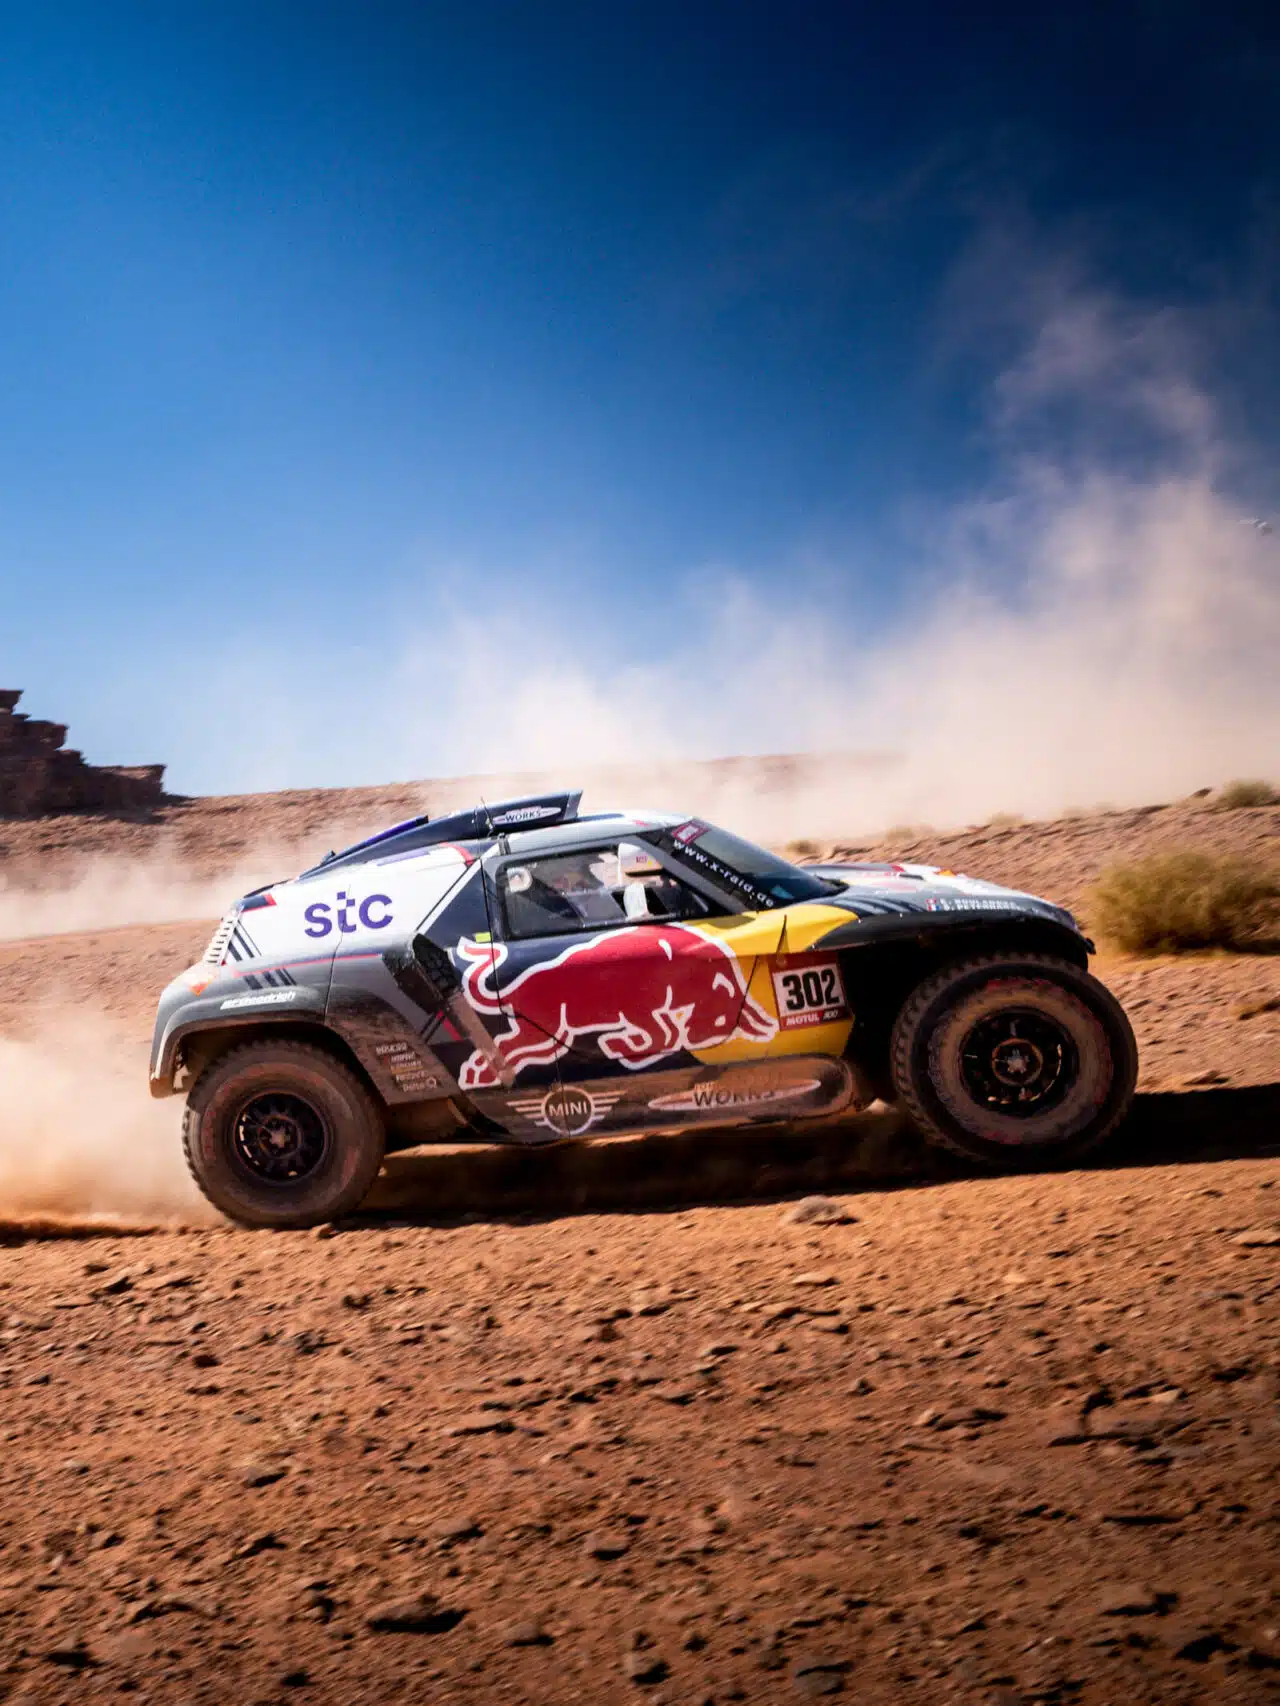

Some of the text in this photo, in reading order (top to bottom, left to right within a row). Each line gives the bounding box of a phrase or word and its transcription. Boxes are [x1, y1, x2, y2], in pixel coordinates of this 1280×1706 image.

[505, 811, 541, 823] WORKS
[782, 968, 839, 1011] 302
[786, 1011, 820, 1025] MOTUL
[549, 1101, 588, 1117] MINI
